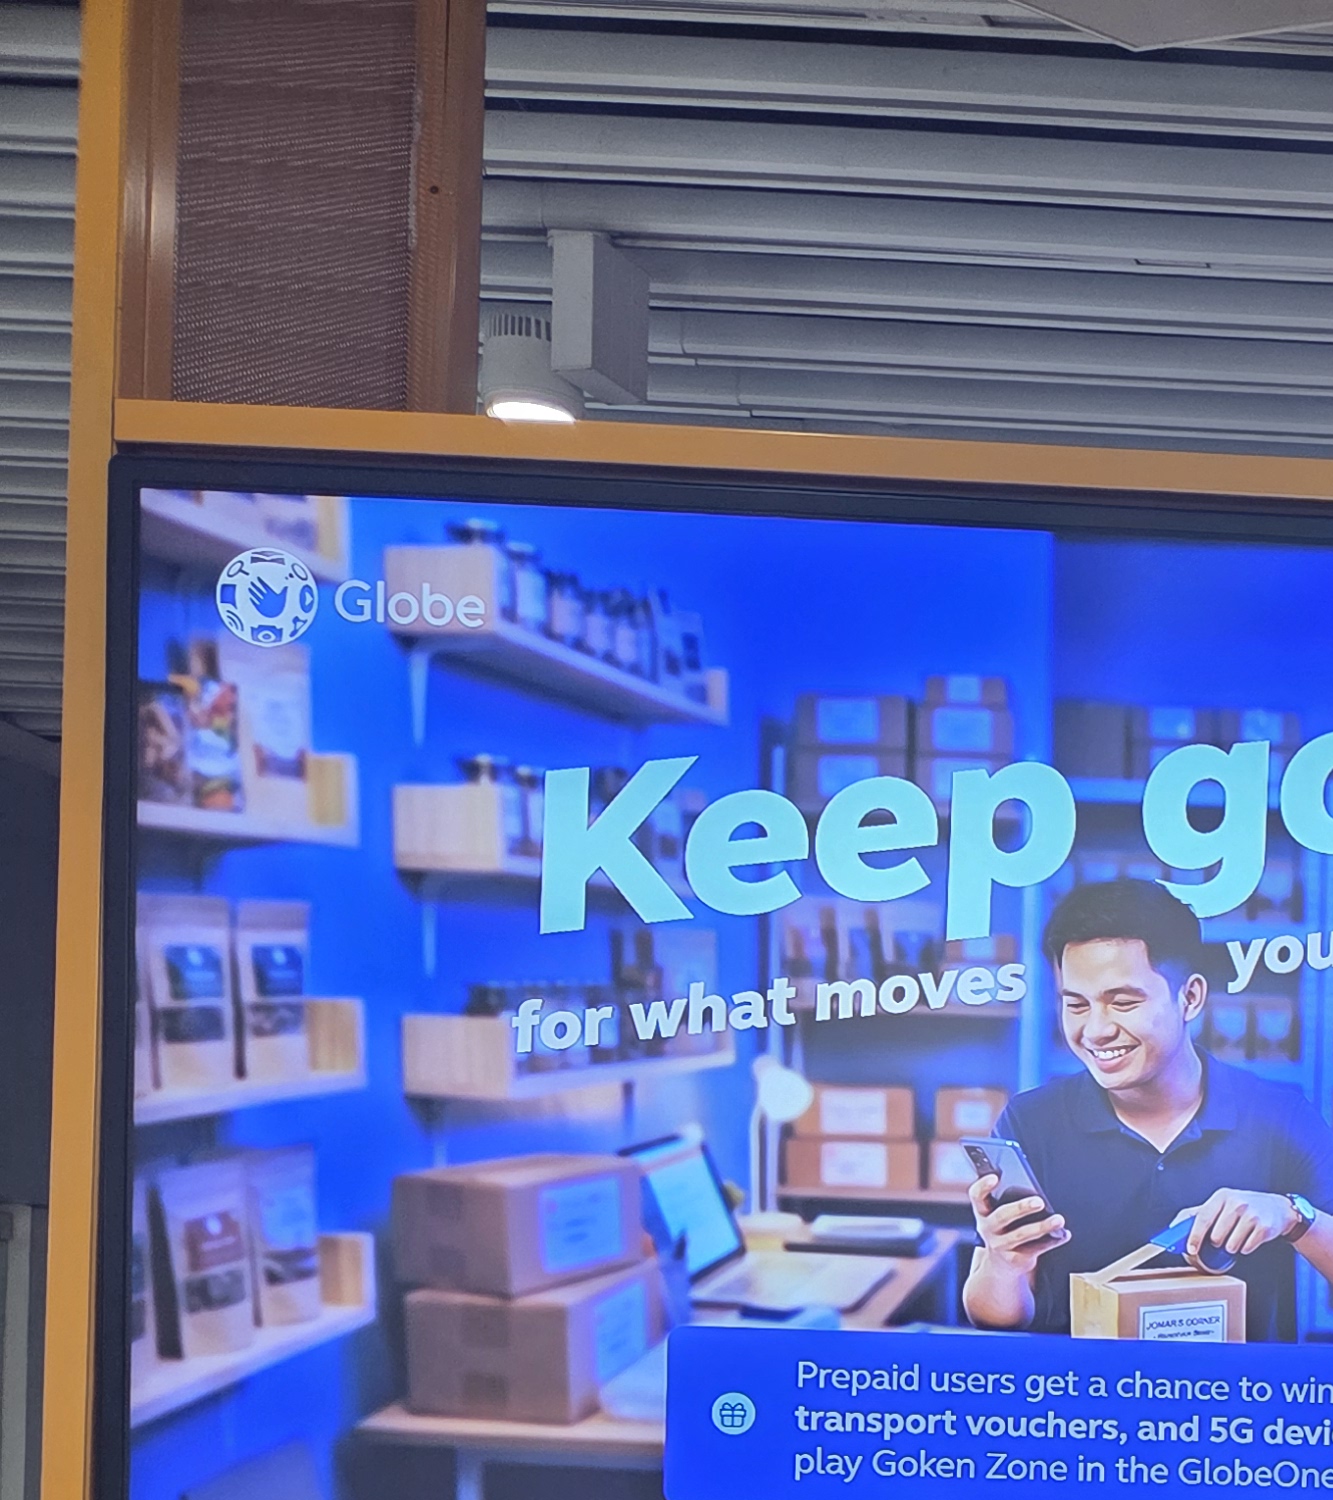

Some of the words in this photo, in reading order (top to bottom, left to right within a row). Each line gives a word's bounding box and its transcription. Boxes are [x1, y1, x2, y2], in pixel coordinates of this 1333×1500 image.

[334, 579, 486, 627] Globe
[540, 755, 1077, 941] Keep
[512, 998, 618, 1053] for
[629, 976, 796, 1041] what
[816, 963, 1027, 1022] moves
[799, 1362, 919, 1396] Prepaid
[931, 1371, 1015, 1394] users
[1025, 1371, 1079, 1402] get
[1088, 1377, 1108, 1397] a
[1116, 1371, 1229, 1401] chance
[1238, 1377, 1273, 1402] to
[795, 1405, 957, 1440] transport
[965, 1411, 1128, 1445] vouchers,
[1137, 1416, 1199, 1442] and
[1209, 1417, 1254, 1443] 5G
[795, 1447, 863, 1483] play
[872, 1449, 975, 1478] Goken
[985, 1453, 1068, 1481] Zone
[1078, 1455, 1105, 1482] in
[1115, 1456, 1169, 1484] the
